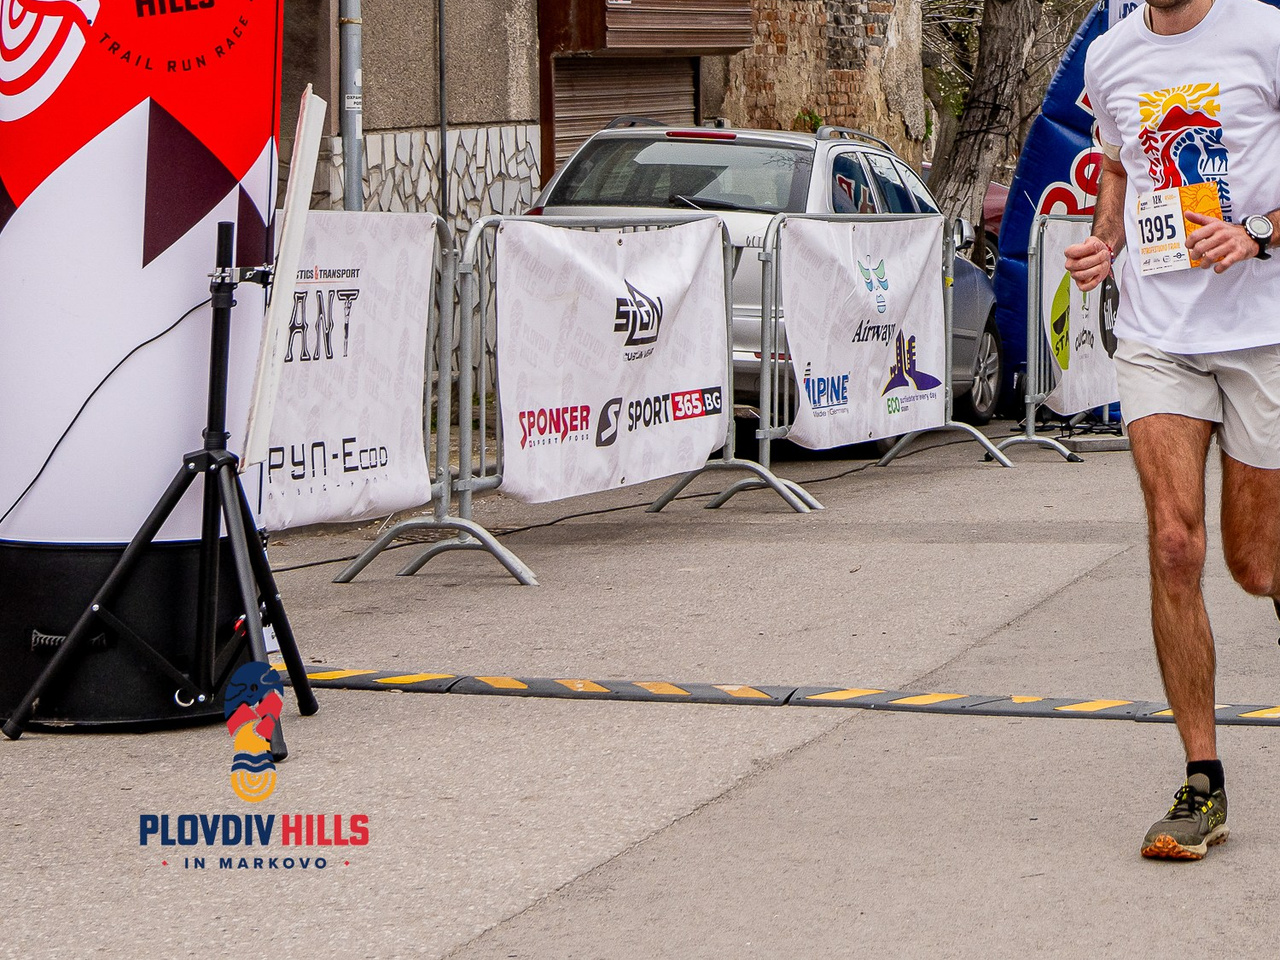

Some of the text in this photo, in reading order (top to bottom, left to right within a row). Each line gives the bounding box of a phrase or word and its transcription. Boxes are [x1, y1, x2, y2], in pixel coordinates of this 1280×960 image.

[98, 15, 248, 72] TRAIL RUN RACE
[1138, 213, 1177, 244] 1395
[319, 268, 360, 279] TRANSPORT
[518, 404, 591, 450] SPONSER
